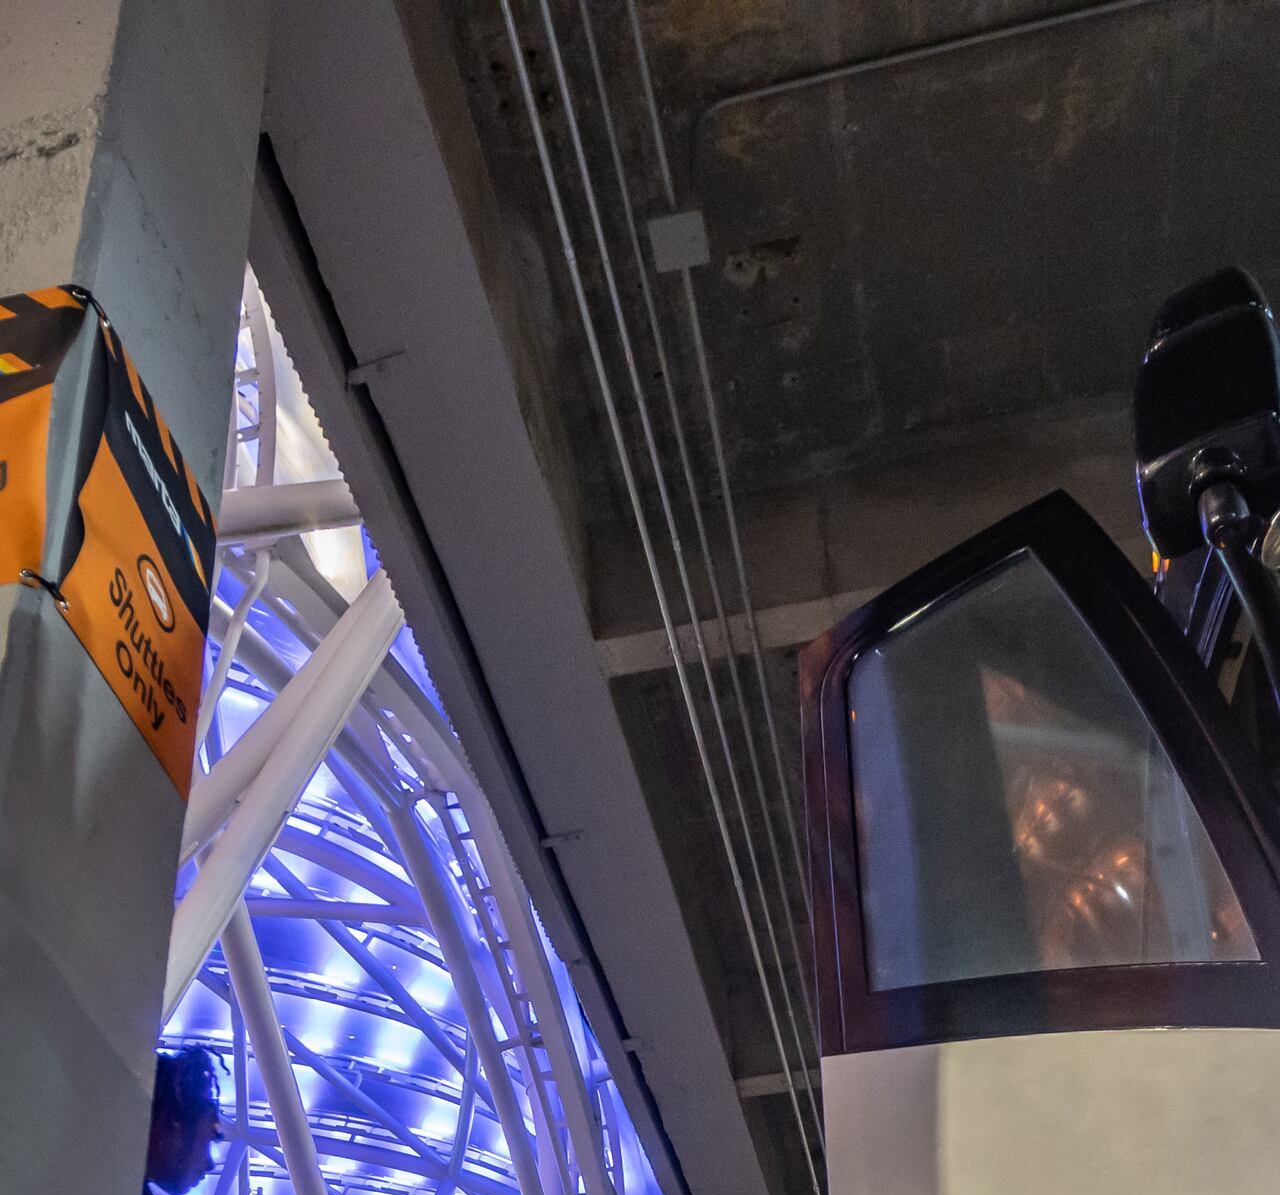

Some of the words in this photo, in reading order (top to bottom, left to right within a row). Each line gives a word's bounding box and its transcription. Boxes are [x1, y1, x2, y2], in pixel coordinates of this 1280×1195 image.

[123, 410, 184, 537] marta
[108, 566, 188, 725] Shuttles
[114, 638, 166, 731] Only
